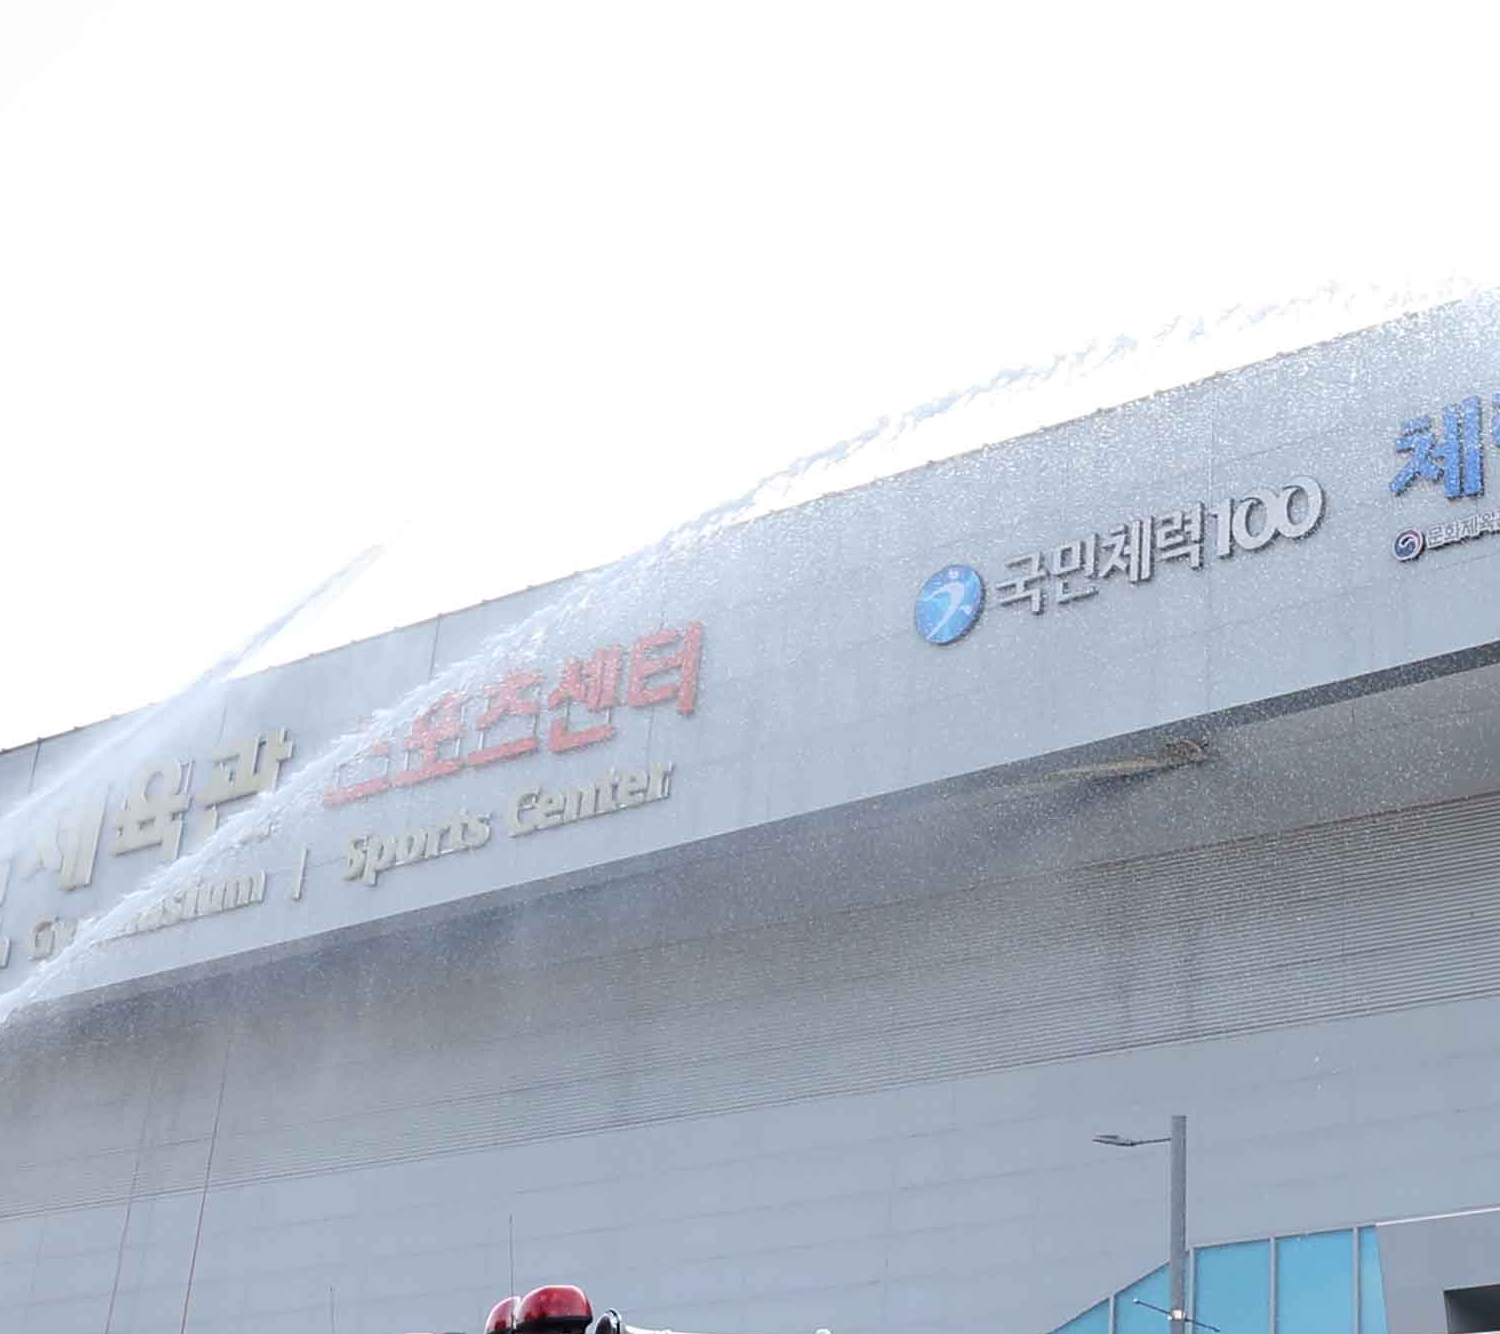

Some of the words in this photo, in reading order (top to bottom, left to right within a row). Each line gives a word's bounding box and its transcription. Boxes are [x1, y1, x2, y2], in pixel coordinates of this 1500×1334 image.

[995, 475, 1326, 614] 국민체력100
[342, 807, 493, 887] Sports
[507, 762, 676, 839] Center
